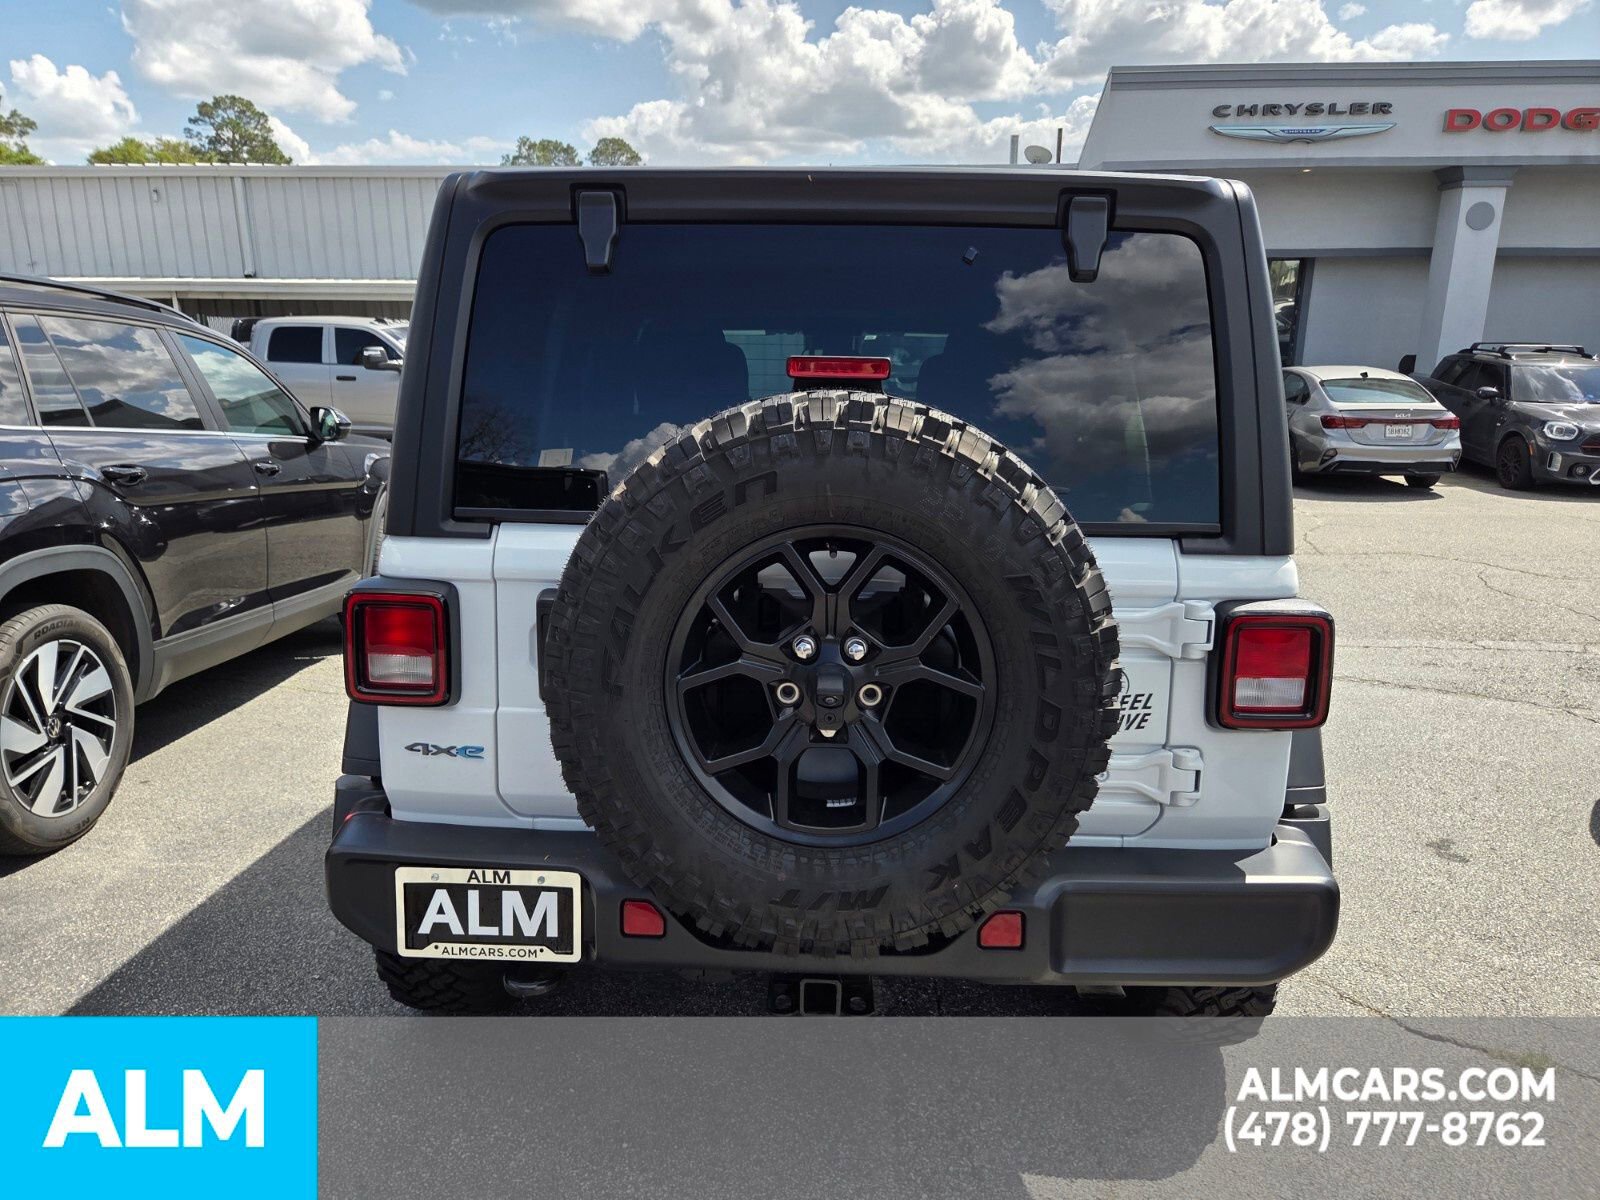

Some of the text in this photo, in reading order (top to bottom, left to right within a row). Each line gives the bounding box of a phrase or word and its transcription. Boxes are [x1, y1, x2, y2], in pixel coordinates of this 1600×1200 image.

[1212, 102, 1393, 118] CHRYSLER
[1443, 107, 1600, 132] DODG
[925, 573, 1063, 892] WILDPEAK
[467, 870, 511, 885] ALM
[417, 889, 559, 938] ALM
[441, 946, 538, 958] ALMCARS.COM
